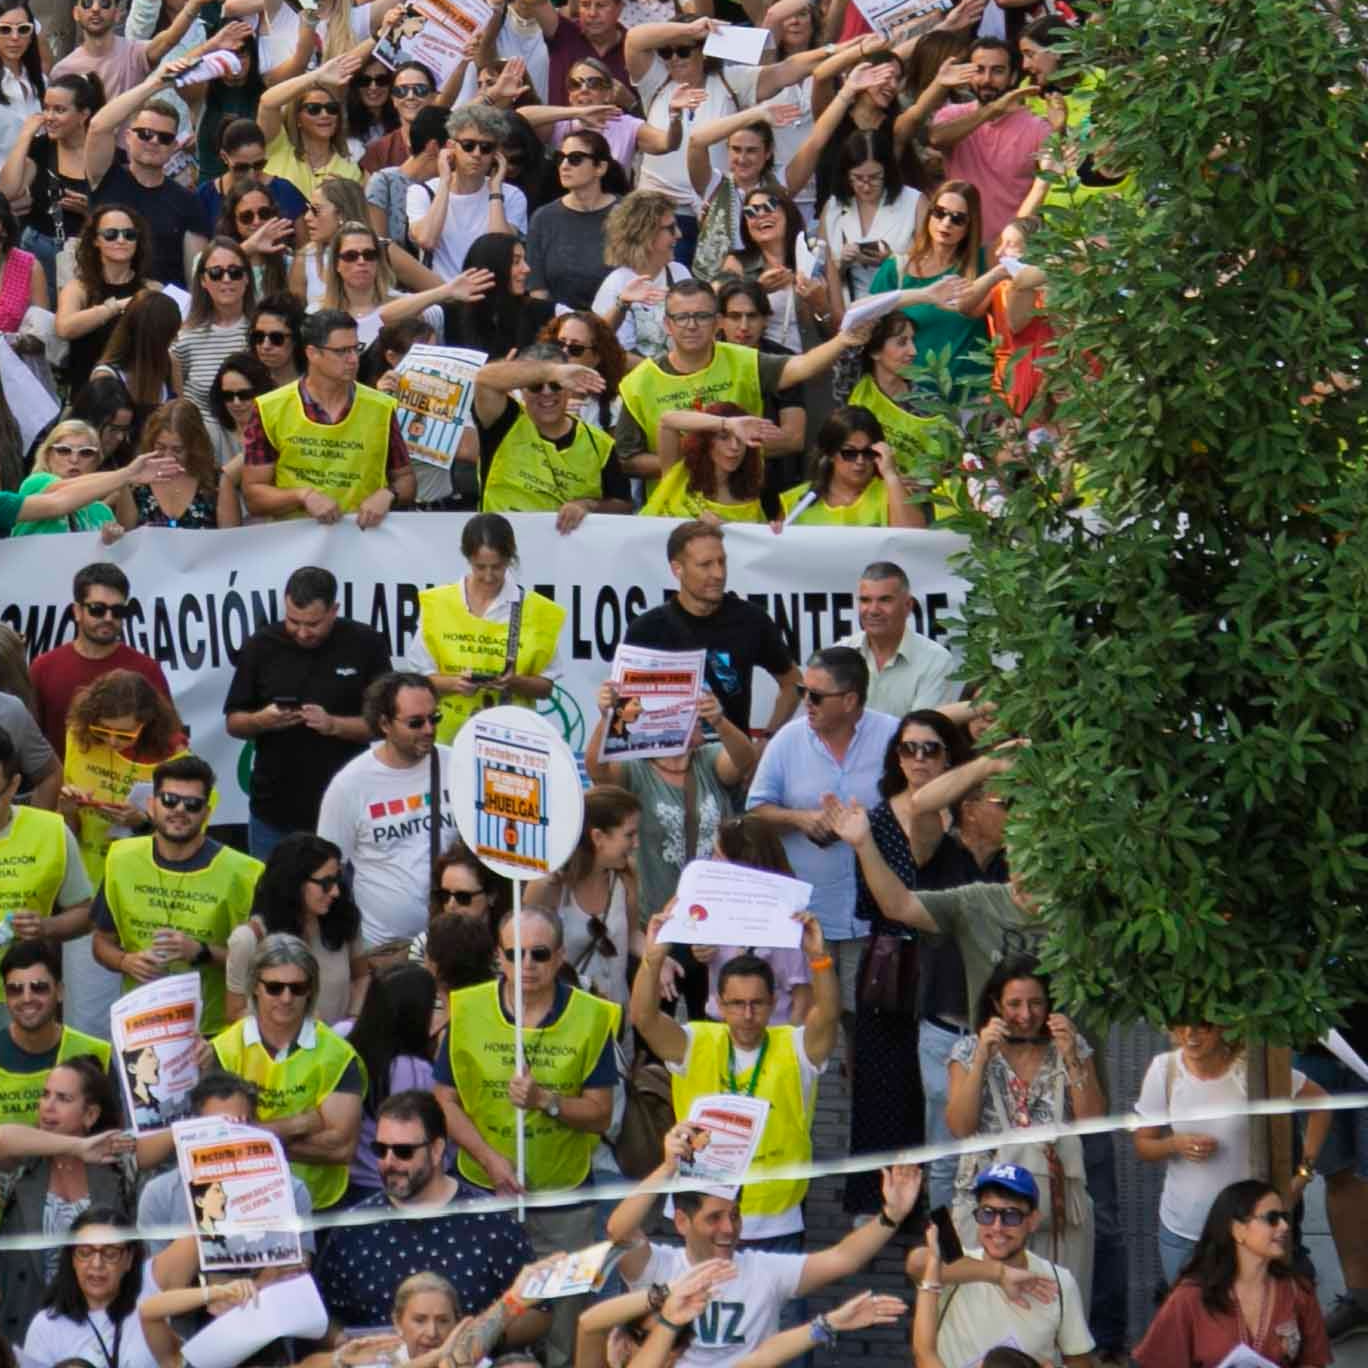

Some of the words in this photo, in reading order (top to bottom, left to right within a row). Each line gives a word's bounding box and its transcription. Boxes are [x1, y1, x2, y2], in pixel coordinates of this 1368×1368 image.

[571, 584, 648, 663] LOS
[484, 792, 540, 819] ¡HUELGA!
[134, 884, 220, 905] HOMOLOGACIÓN
[148, 897, 199, 915] SALARIAL
[987, 1161, 1018, 1181] LA
